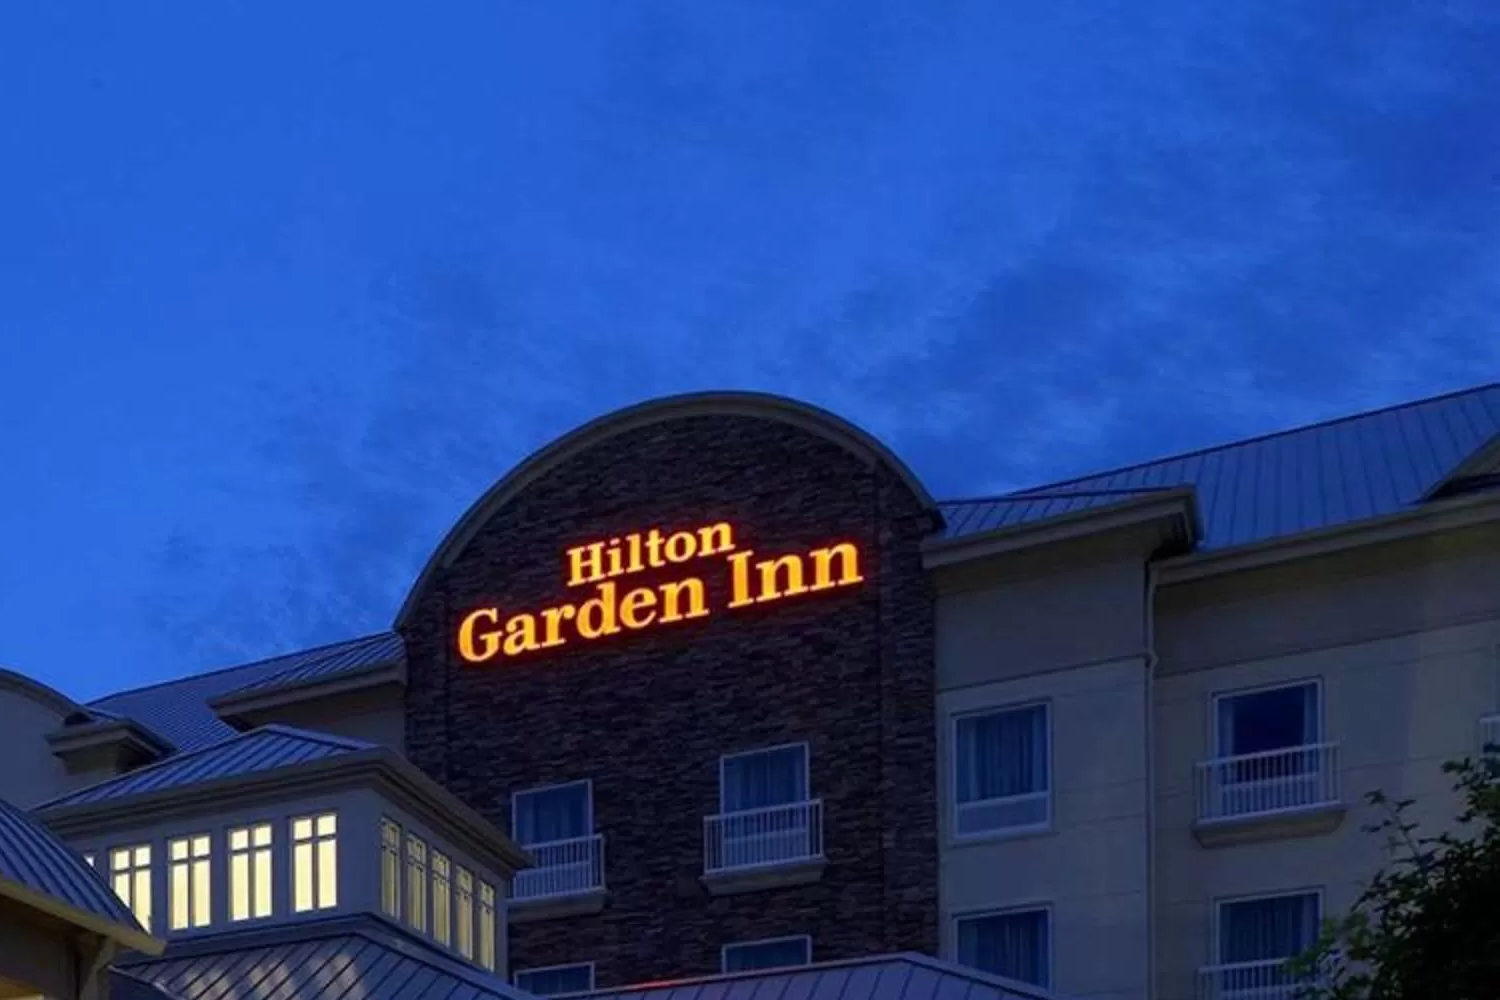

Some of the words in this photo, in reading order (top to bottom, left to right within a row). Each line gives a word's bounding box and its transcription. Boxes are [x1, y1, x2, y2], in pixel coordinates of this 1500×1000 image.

[567, 521, 736, 587] Hilton
[458, 577, 710, 663] Garden
[726, 541, 864, 609] Inn
